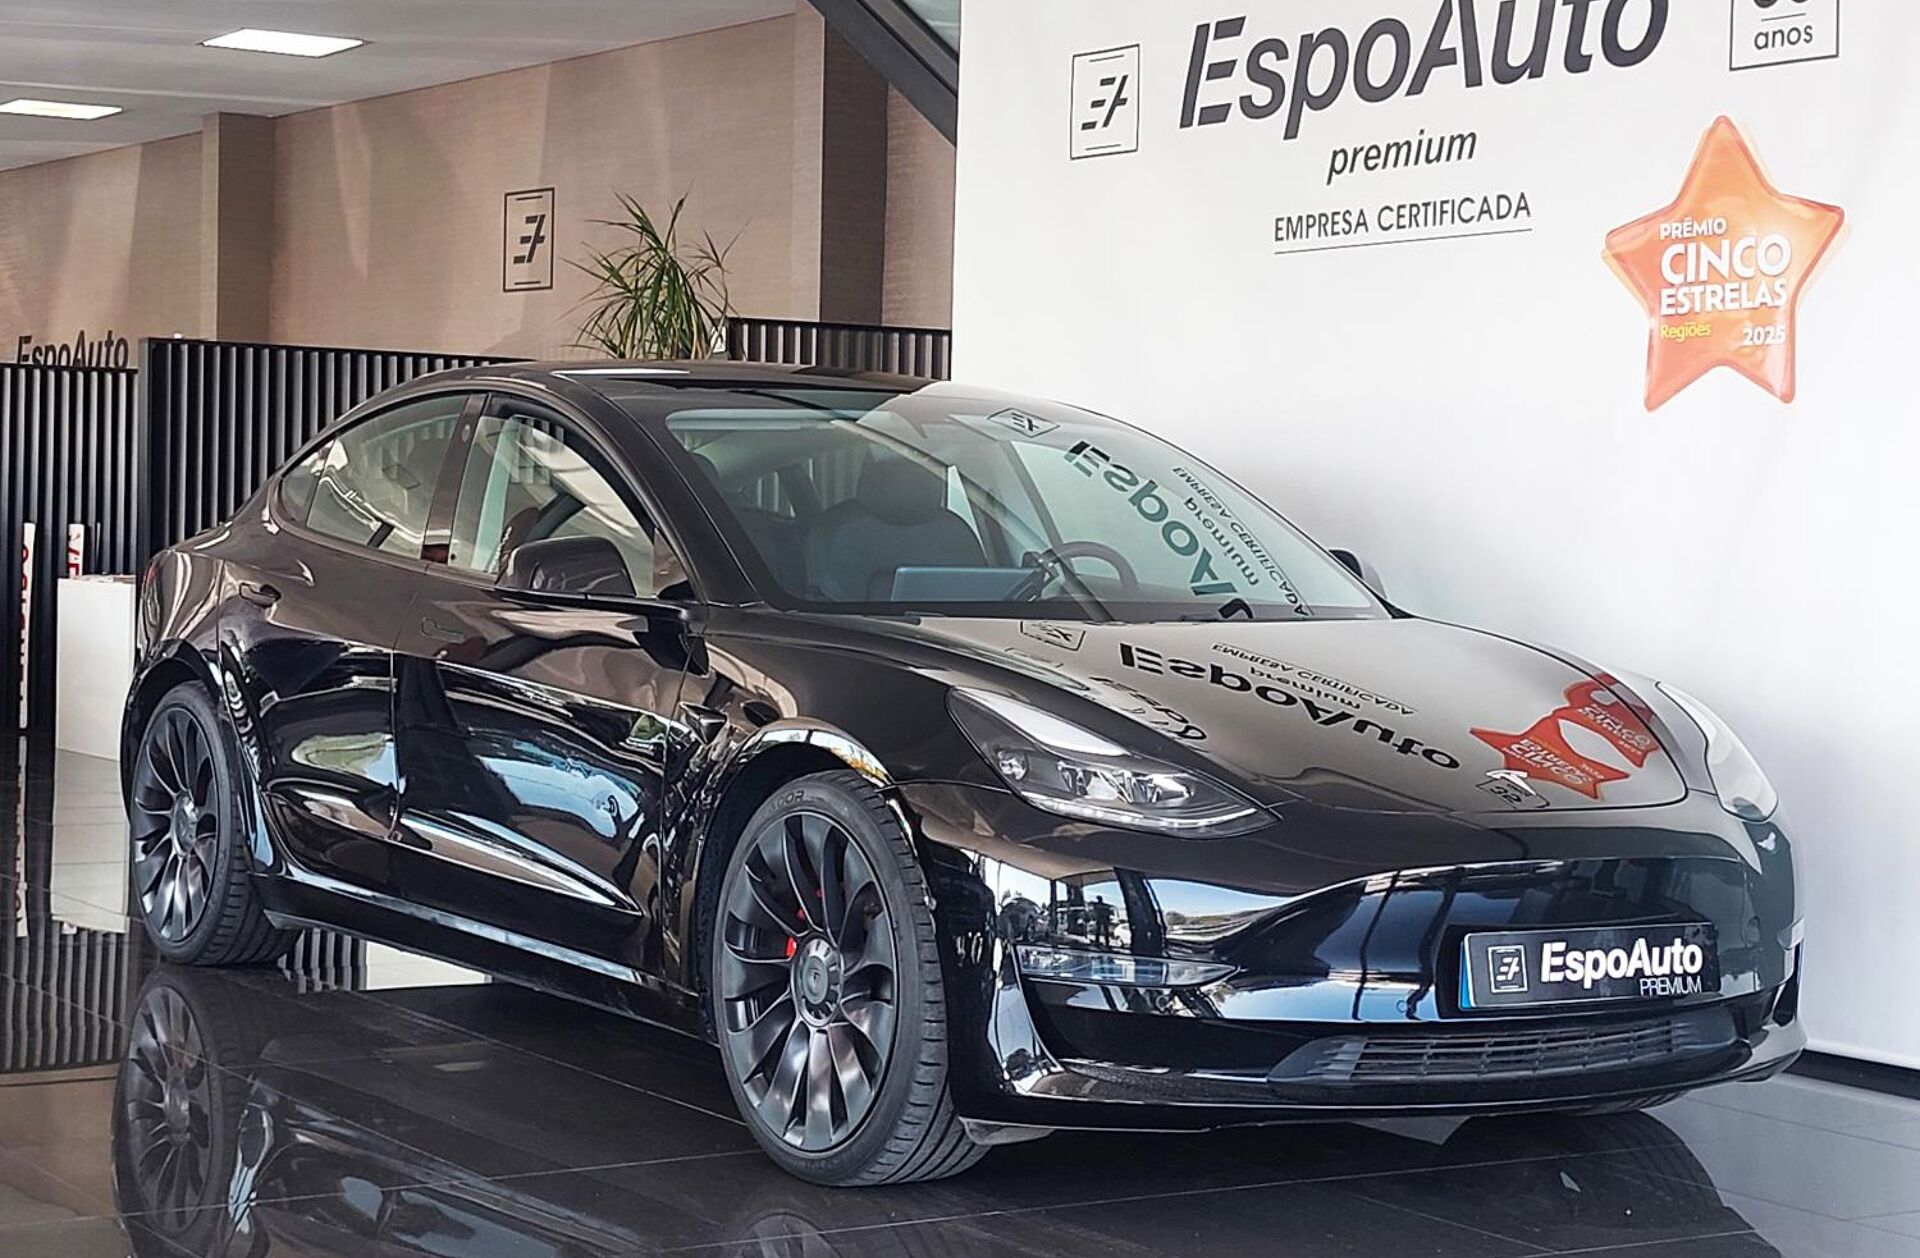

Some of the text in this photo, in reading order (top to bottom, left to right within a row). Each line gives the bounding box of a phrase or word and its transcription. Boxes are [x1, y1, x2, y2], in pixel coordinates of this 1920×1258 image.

[1754, 25, 1813, 50] anos
[1179, 0, 1668, 140] EspoAuto
[1327, 129, 1477, 185] premium
[1274, 192, 1532, 242] EMPRESA CERTIFICADA
[1659, 217, 1728, 241] PRÉMIO
[1660, 234, 1792, 286] CINCO
[1660, 278, 1789, 317] ESTRELAS
[1660, 321, 1786, 347] Regiões 2025
[1541, 937, 1703, 989] EspoAuto
[1640, 975, 1702, 996] PREMIUM
